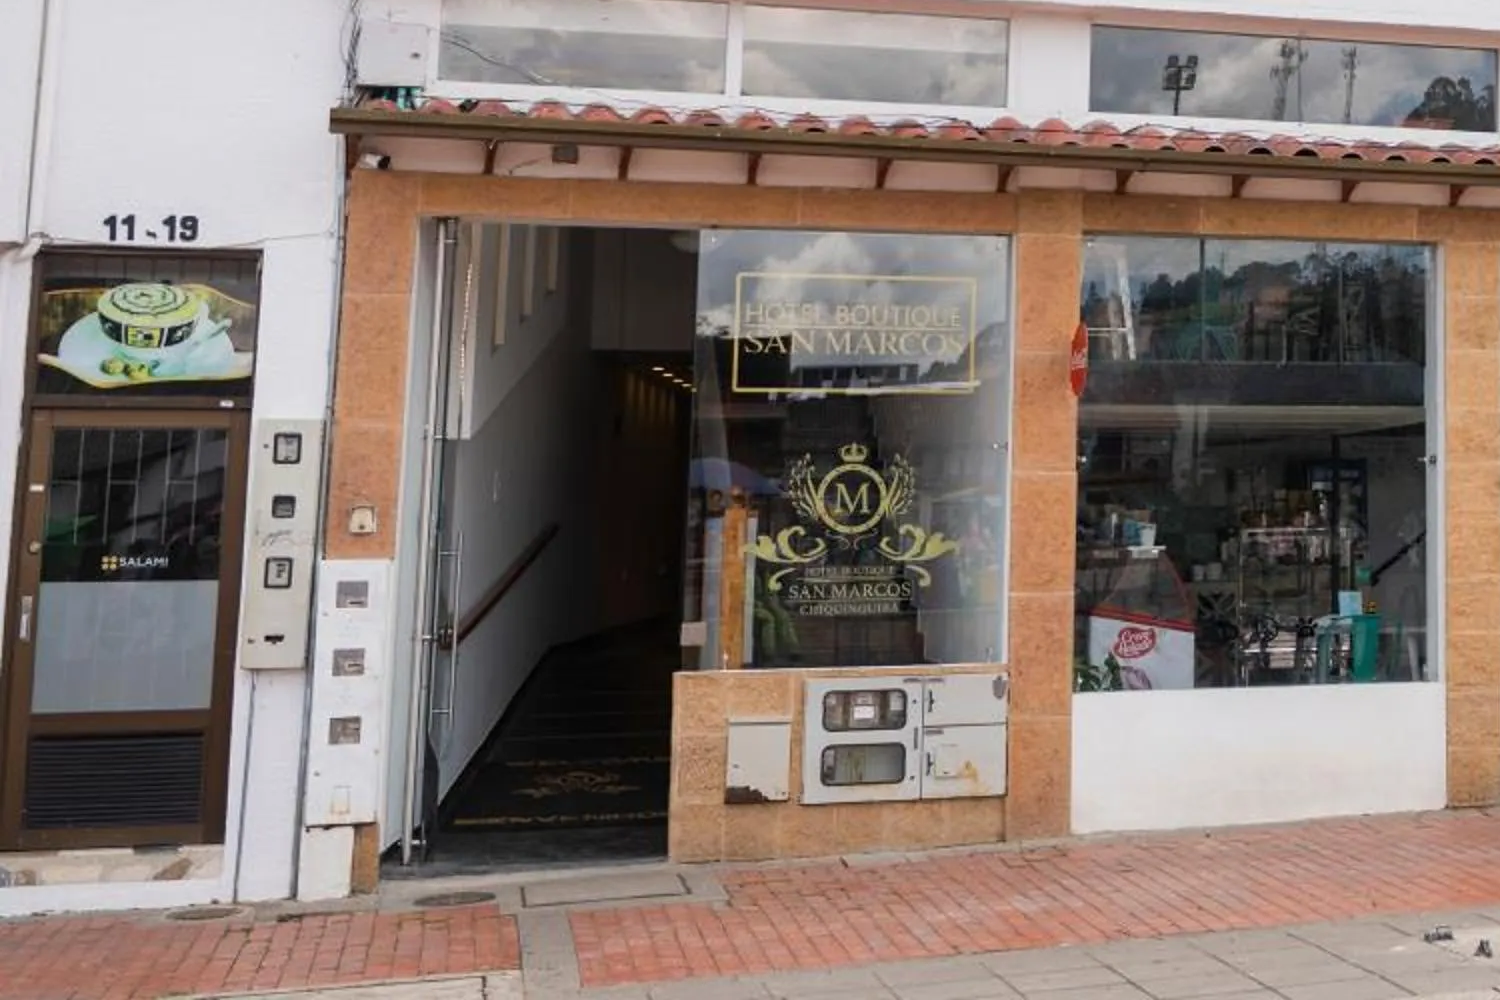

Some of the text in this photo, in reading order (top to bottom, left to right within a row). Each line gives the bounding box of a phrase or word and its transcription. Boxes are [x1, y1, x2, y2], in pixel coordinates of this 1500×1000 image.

[745, 303, 961, 328] HOTEL BOUTIQUE
[744, 330, 965, 357] SAN MARCOS
[834, 483, 871, 514] M
[119, 556, 169, 568] SALAMI
[788, 582, 912, 600] SAN MARCOS
